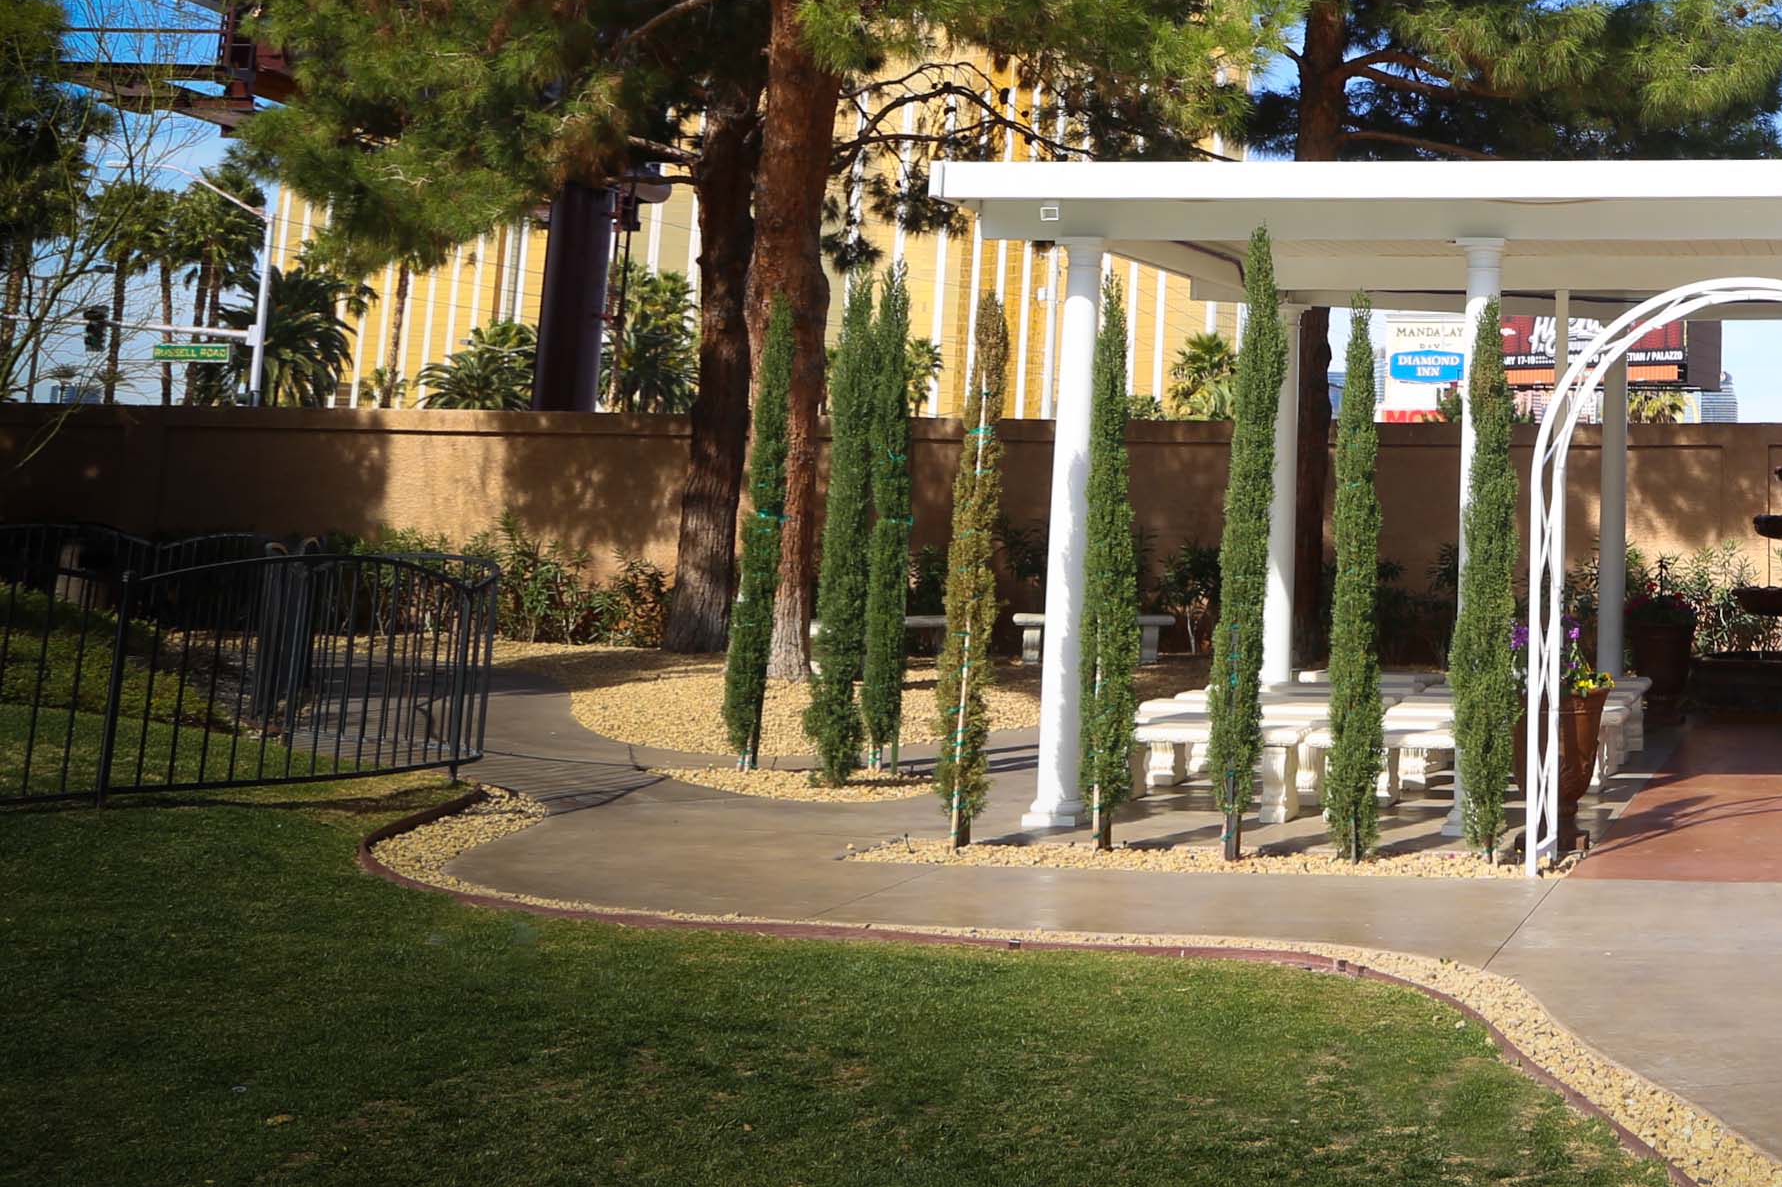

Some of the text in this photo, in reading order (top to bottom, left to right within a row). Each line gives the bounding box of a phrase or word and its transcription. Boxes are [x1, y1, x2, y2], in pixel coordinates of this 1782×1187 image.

[200, 347, 226, 358] ROAD
[1651, 350, 1683, 362] PALAZZO
[1397, 355, 1460, 366] DIAMOND
[1416, 367, 1440, 377] INN
